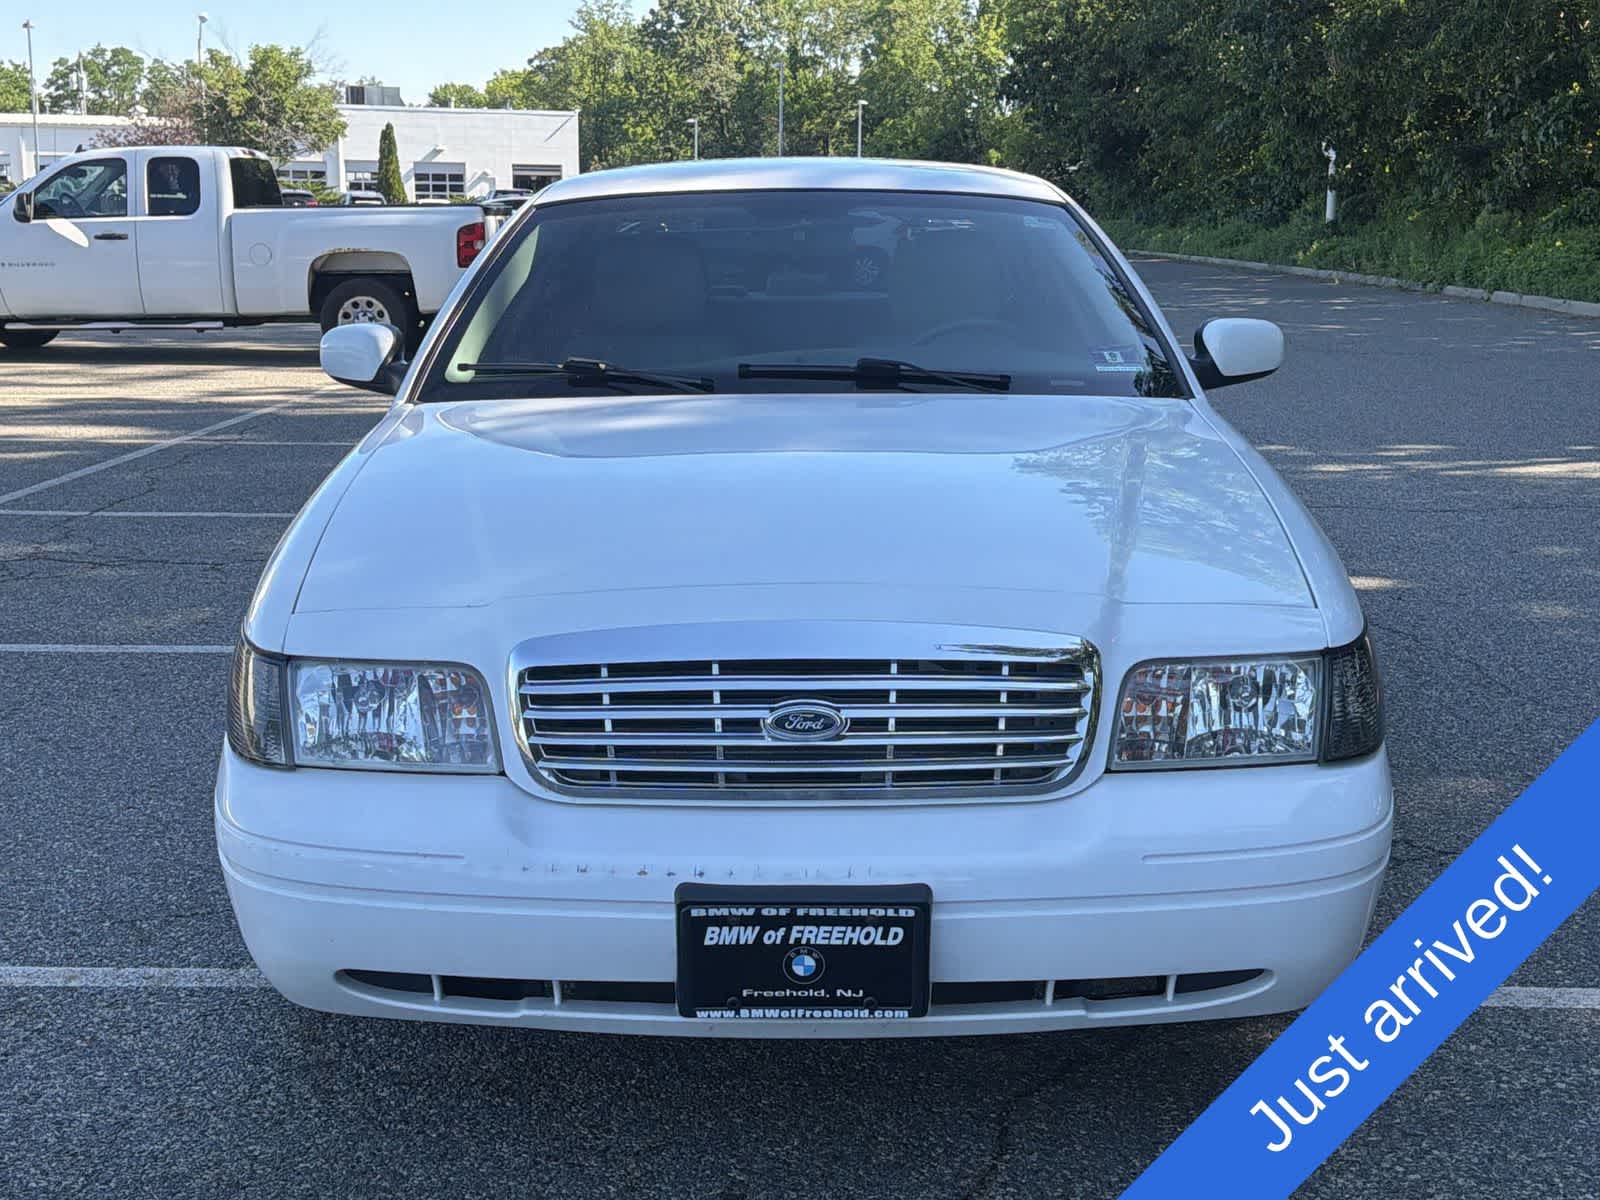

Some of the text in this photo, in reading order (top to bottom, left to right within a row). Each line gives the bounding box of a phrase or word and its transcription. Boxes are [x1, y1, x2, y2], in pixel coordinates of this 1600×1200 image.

[784, 713, 824, 729] Ford
[690, 907, 916, 917] BMW OF FREEHOLD
[703, 925, 904, 946] BMW of FREEHOLD
[836, 988, 864, 998] NJ
[695, 1008, 909, 1019] www.BMWofFreehold.com
